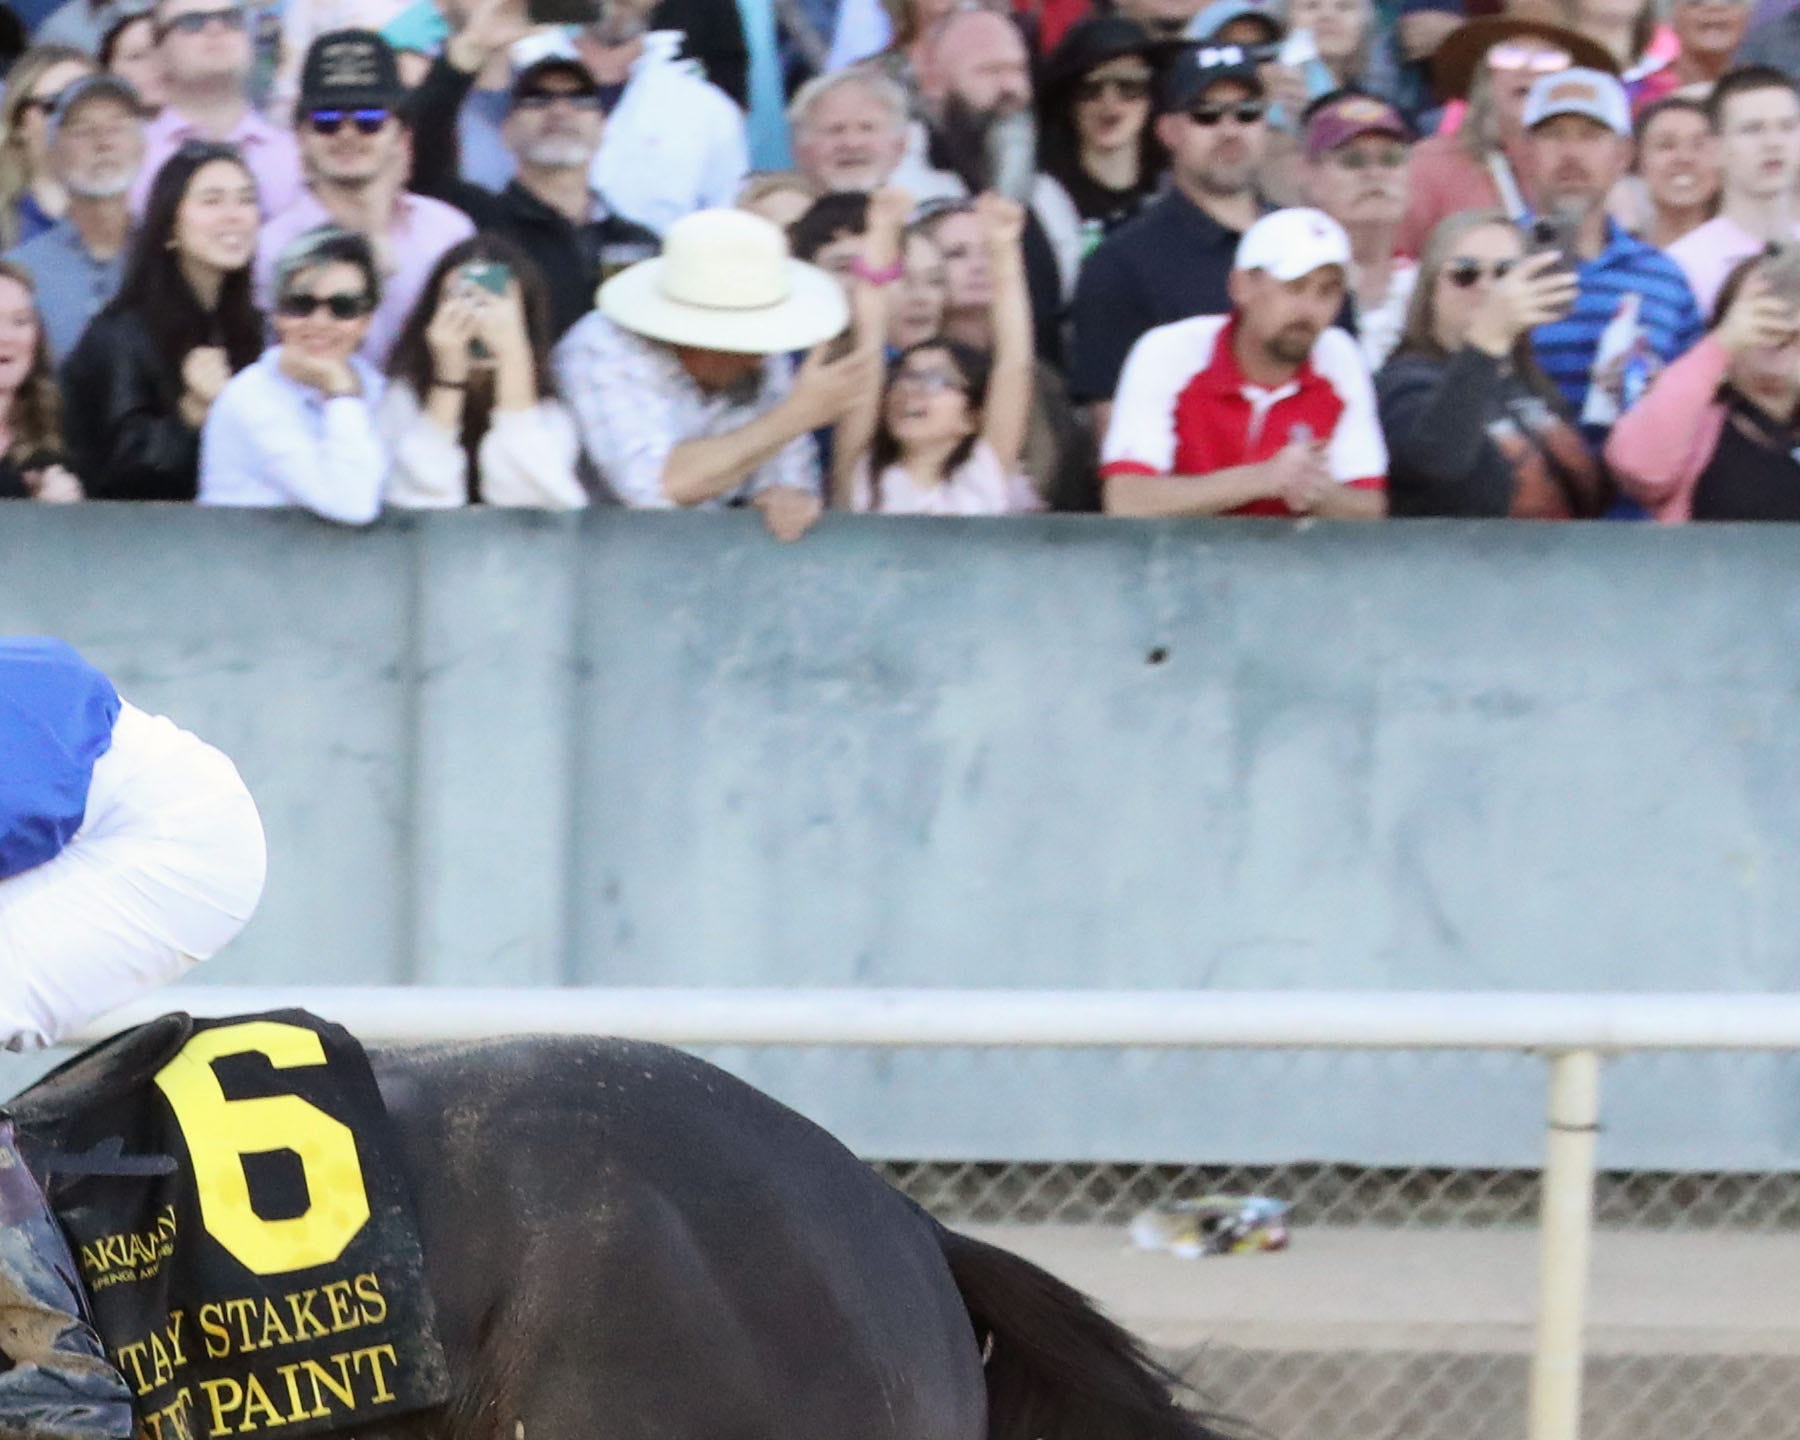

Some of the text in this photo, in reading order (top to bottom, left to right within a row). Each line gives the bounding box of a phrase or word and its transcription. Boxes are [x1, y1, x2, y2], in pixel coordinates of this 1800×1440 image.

[154, 1020, 372, 1276] 6
[200, 1272, 388, 1359] STAKES
[200, 1344, 399, 1438] PAINT
